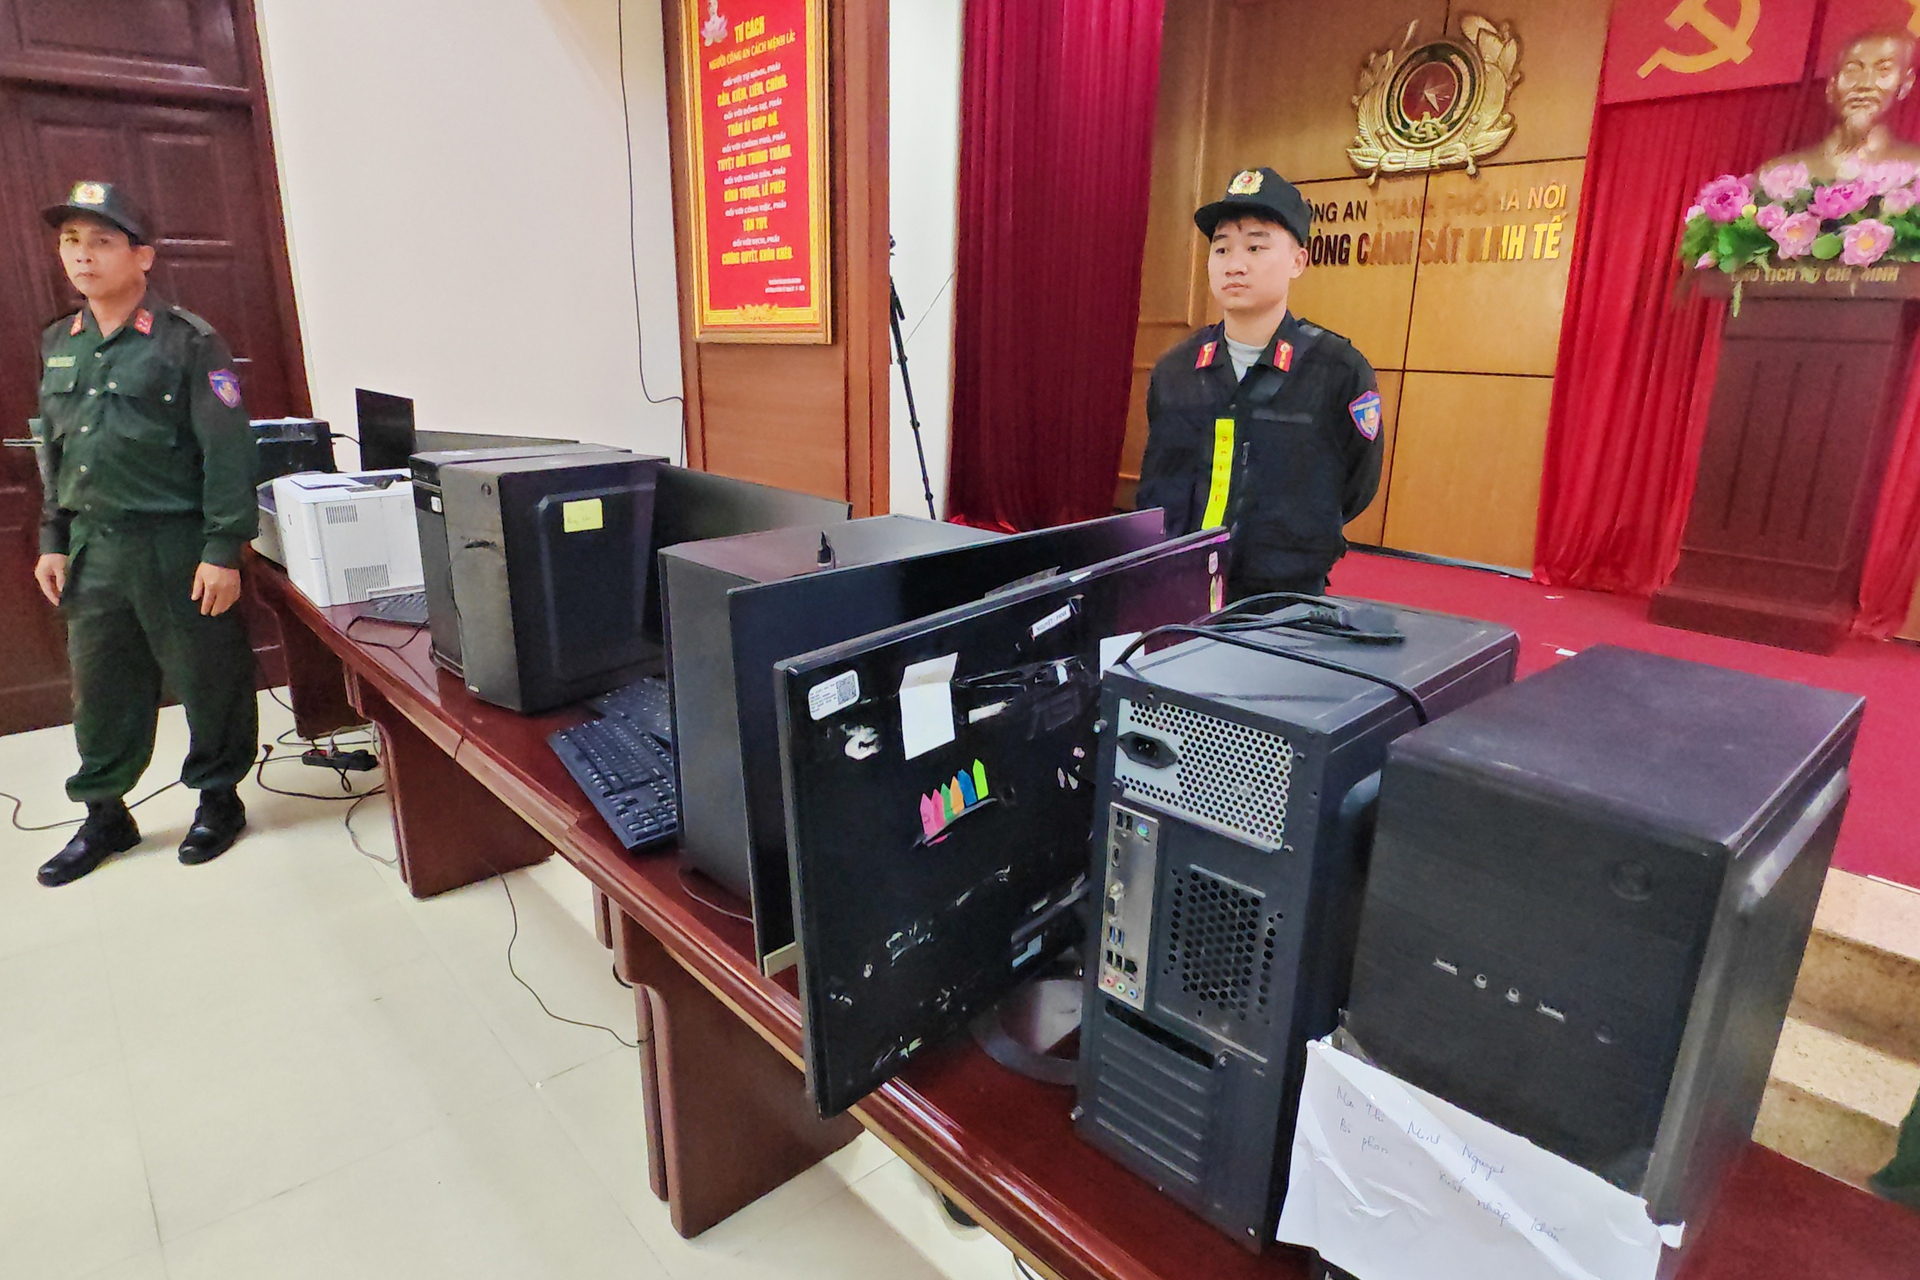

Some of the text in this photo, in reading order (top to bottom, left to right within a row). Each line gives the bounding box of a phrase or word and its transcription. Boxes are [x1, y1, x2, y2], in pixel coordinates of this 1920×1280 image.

[751, 41, 767, 56] CÁCH
[1343, 200, 1368, 223] AN
[1420, 222, 1464, 265] SÁT
[1532, 212, 1569, 260] TẾ
